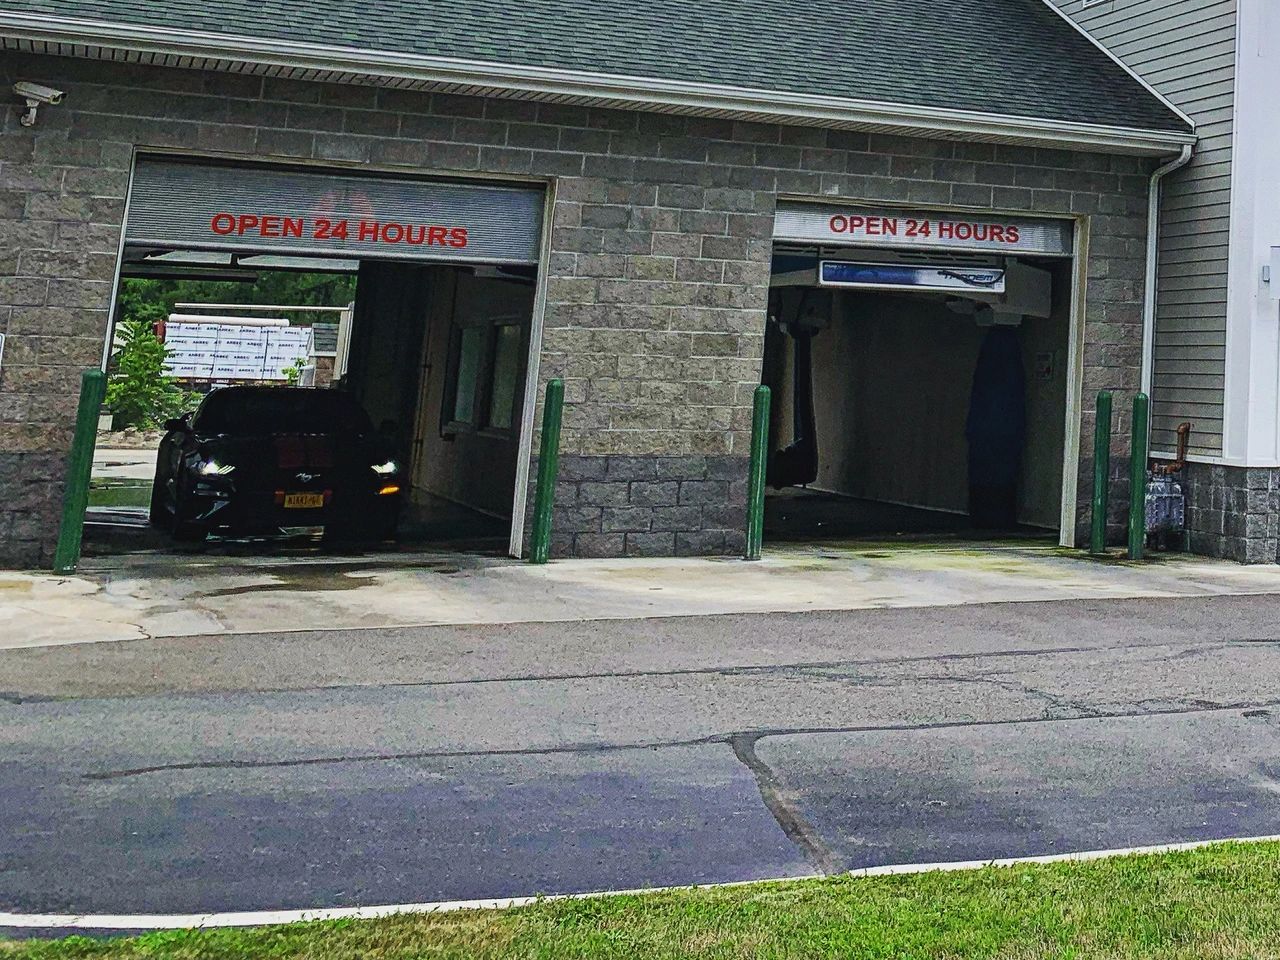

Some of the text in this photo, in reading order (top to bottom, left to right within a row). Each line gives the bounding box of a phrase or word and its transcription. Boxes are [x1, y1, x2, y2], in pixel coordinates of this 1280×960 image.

[210, 213, 468, 248] OPEN 24 HOURS
[829, 215, 1020, 243] OPEN 24 HOURS
